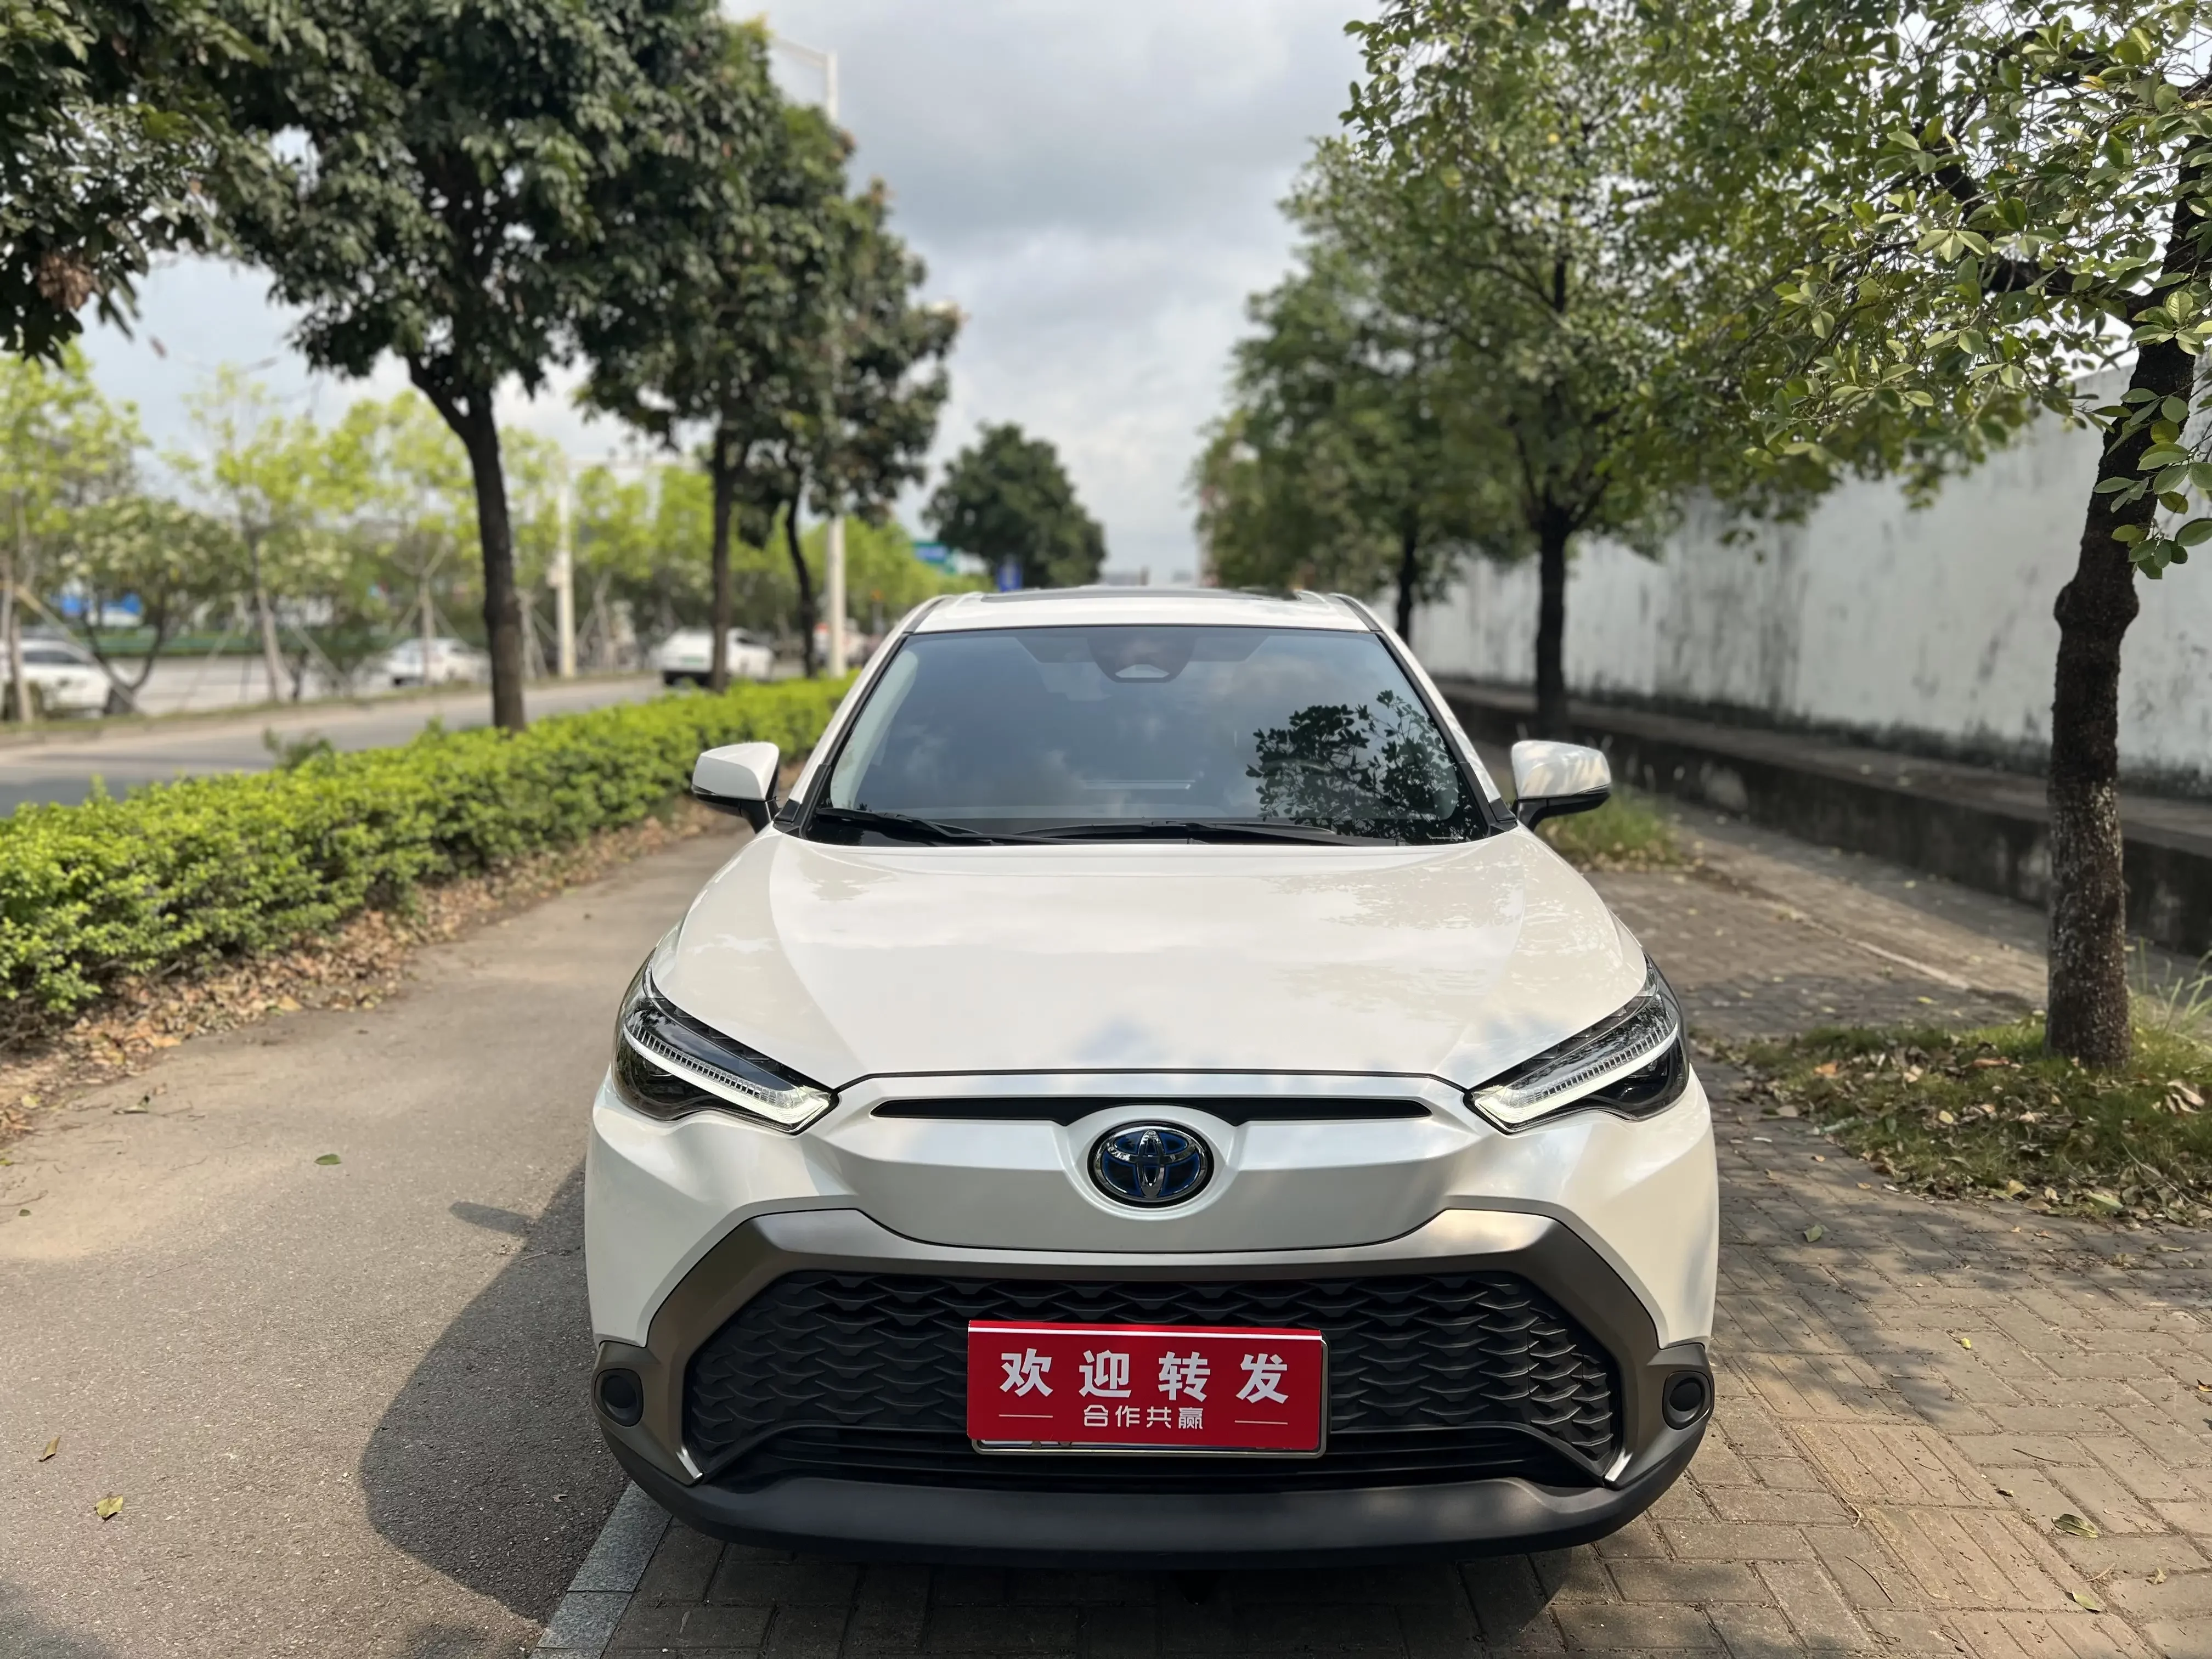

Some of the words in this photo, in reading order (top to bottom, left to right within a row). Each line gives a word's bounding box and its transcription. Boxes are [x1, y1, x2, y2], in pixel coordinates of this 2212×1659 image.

[1000, 1347, 1289, 1404] 欢迎转发
[1084, 1404, 1204, 1430] 合作共赢
